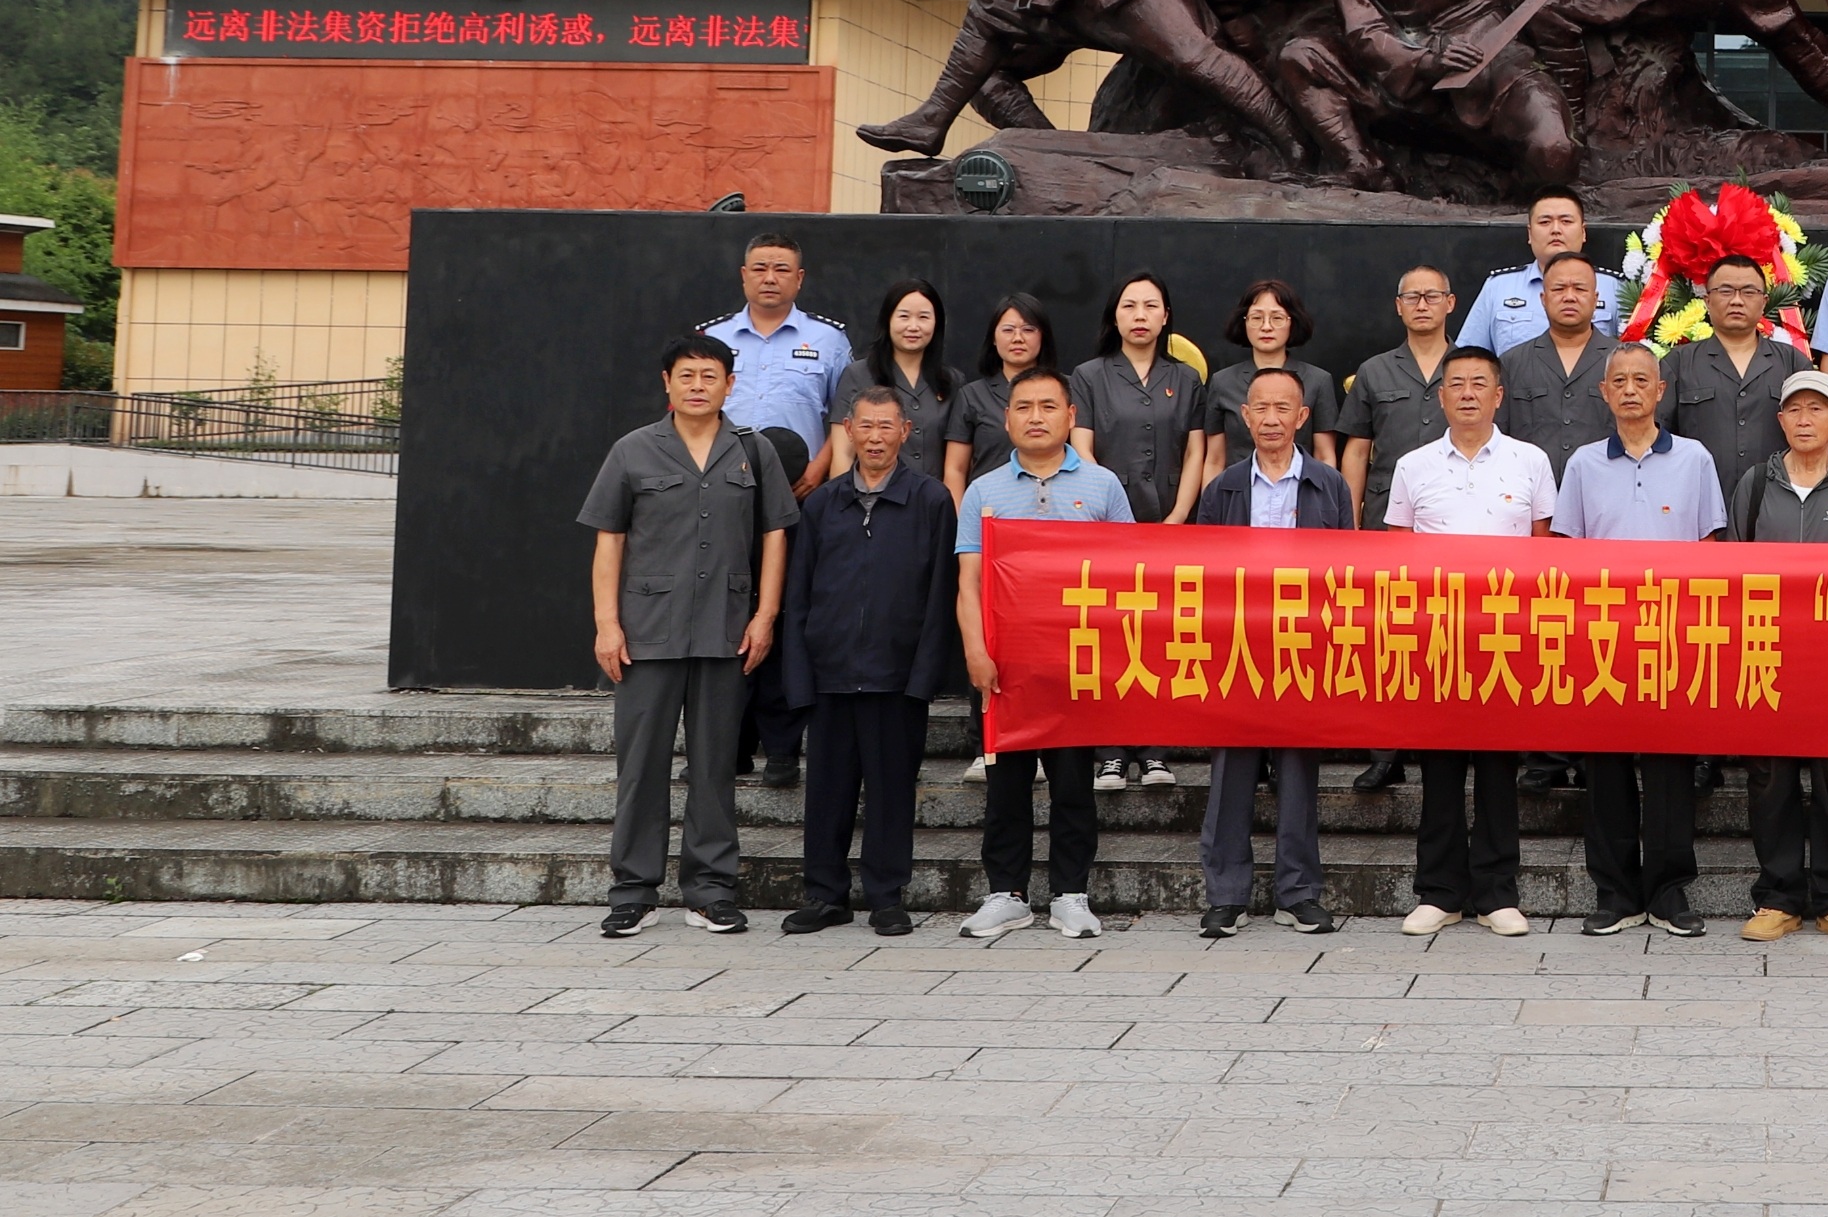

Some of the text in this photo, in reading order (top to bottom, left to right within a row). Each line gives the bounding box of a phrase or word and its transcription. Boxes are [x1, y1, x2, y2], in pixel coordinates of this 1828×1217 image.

[183, 9, 809, 48] 远离非法集资拒绝高利诱惑，远离非法集
